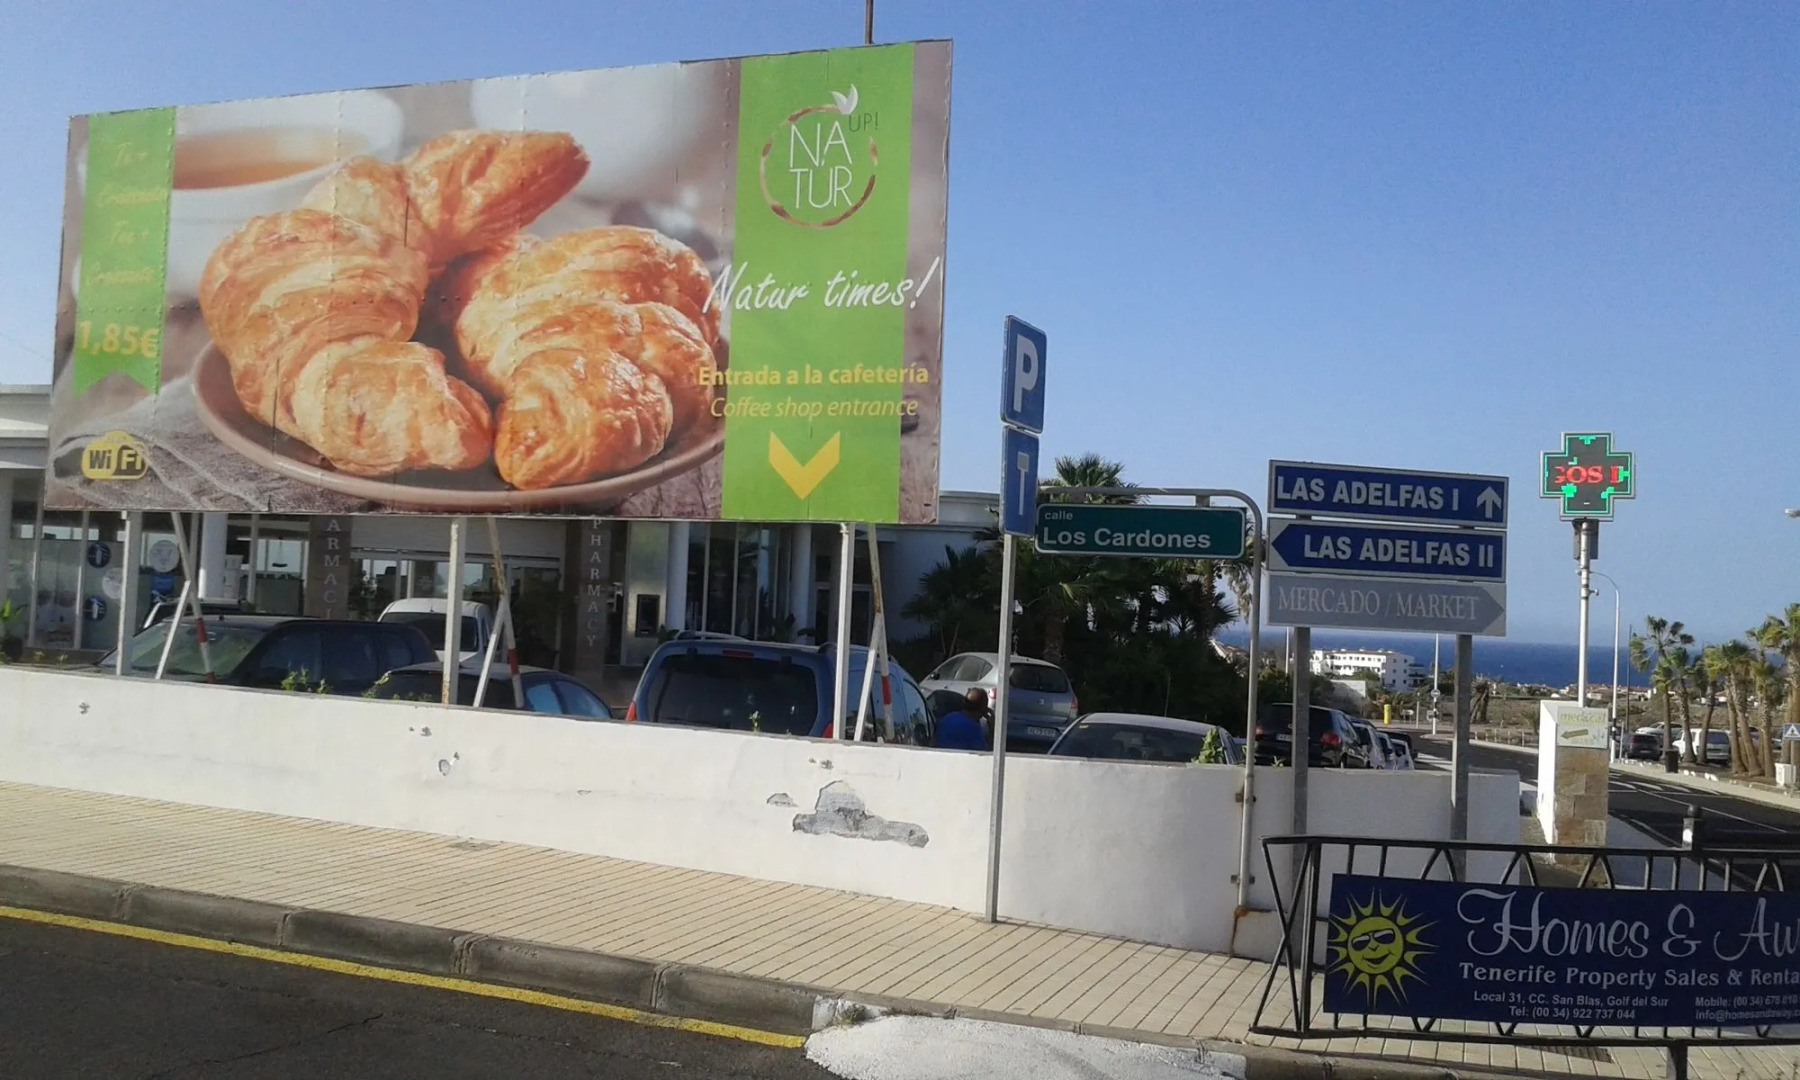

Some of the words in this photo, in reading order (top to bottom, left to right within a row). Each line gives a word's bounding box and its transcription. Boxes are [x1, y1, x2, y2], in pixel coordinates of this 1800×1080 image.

[847, 111, 879, 133] UP!
[789, 120, 853, 168] NA
[789, 165, 853, 209] TUR
[702, 261, 809, 314] Natur
[823, 256, 941, 310] times!
[80, 320, 160, 358] 1,85€
[699, 365, 781, 386] Entrada
[786, 371, 799, 386] a
[804, 365, 823, 386] la
[828, 362, 929, 386] cafetería
[1013, 333, 1040, 413] P
[710, 398, 772, 418] Coffee
[776, 397, 823, 422] shop
[827, 399, 919, 417] entrance
[1277, 476, 1325, 502] LAS
[1332, 480, 1444, 511] ADELFAS
[1452, 488, 1459, 511] I
[1044, 510, 1074, 521] calle
[1043, 527, 1086, 546] Los
[1094, 528, 1211, 549] Cardones
[1304, 534, 1352, 560] LAS
[1359, 538, 1471, 567] ADELFAS
[1478, 544, 1494, 568] II
[1277, 586, 1381, 616] MERCADO
[1396, 592, 1480, 620] MARKET
[1457, 888, 1650, 958] Homes
[1662, 903, 1702, 957] &
[1459, 962, 1556, 984] Tenerife
[1566, 967, 1657, 990] Property
[1664, 969, 1719, 986] Sales
[1727, 968, 1743, 986] &
[1751, 968, 1800, 986] Renta
[1474, 990, 1505, 1002] Local
[1528, 993, 1549, 1004] CC.
[1552, 994, 1576, 1005] San
[1577, 995, 1604, 1007] Blas,
[1606, 995, 1631, 1006] Golf
[1632, 996, 1648, 1006] del
[1650, 996, 1669, 1007] Sur
[1509, 1006, 1529, 1017] Tel:
[1532, 1007, 1550, 1019] (00
[1552, 1007, 1571, 1020] 34)
[1572, 1008, 1592, 1019] 922
[1595, 1008, 1613, 1019] 737
[1616, 1009, 1636, 1019] 044
[1695, 996, 1731, 1007] Mobile:
